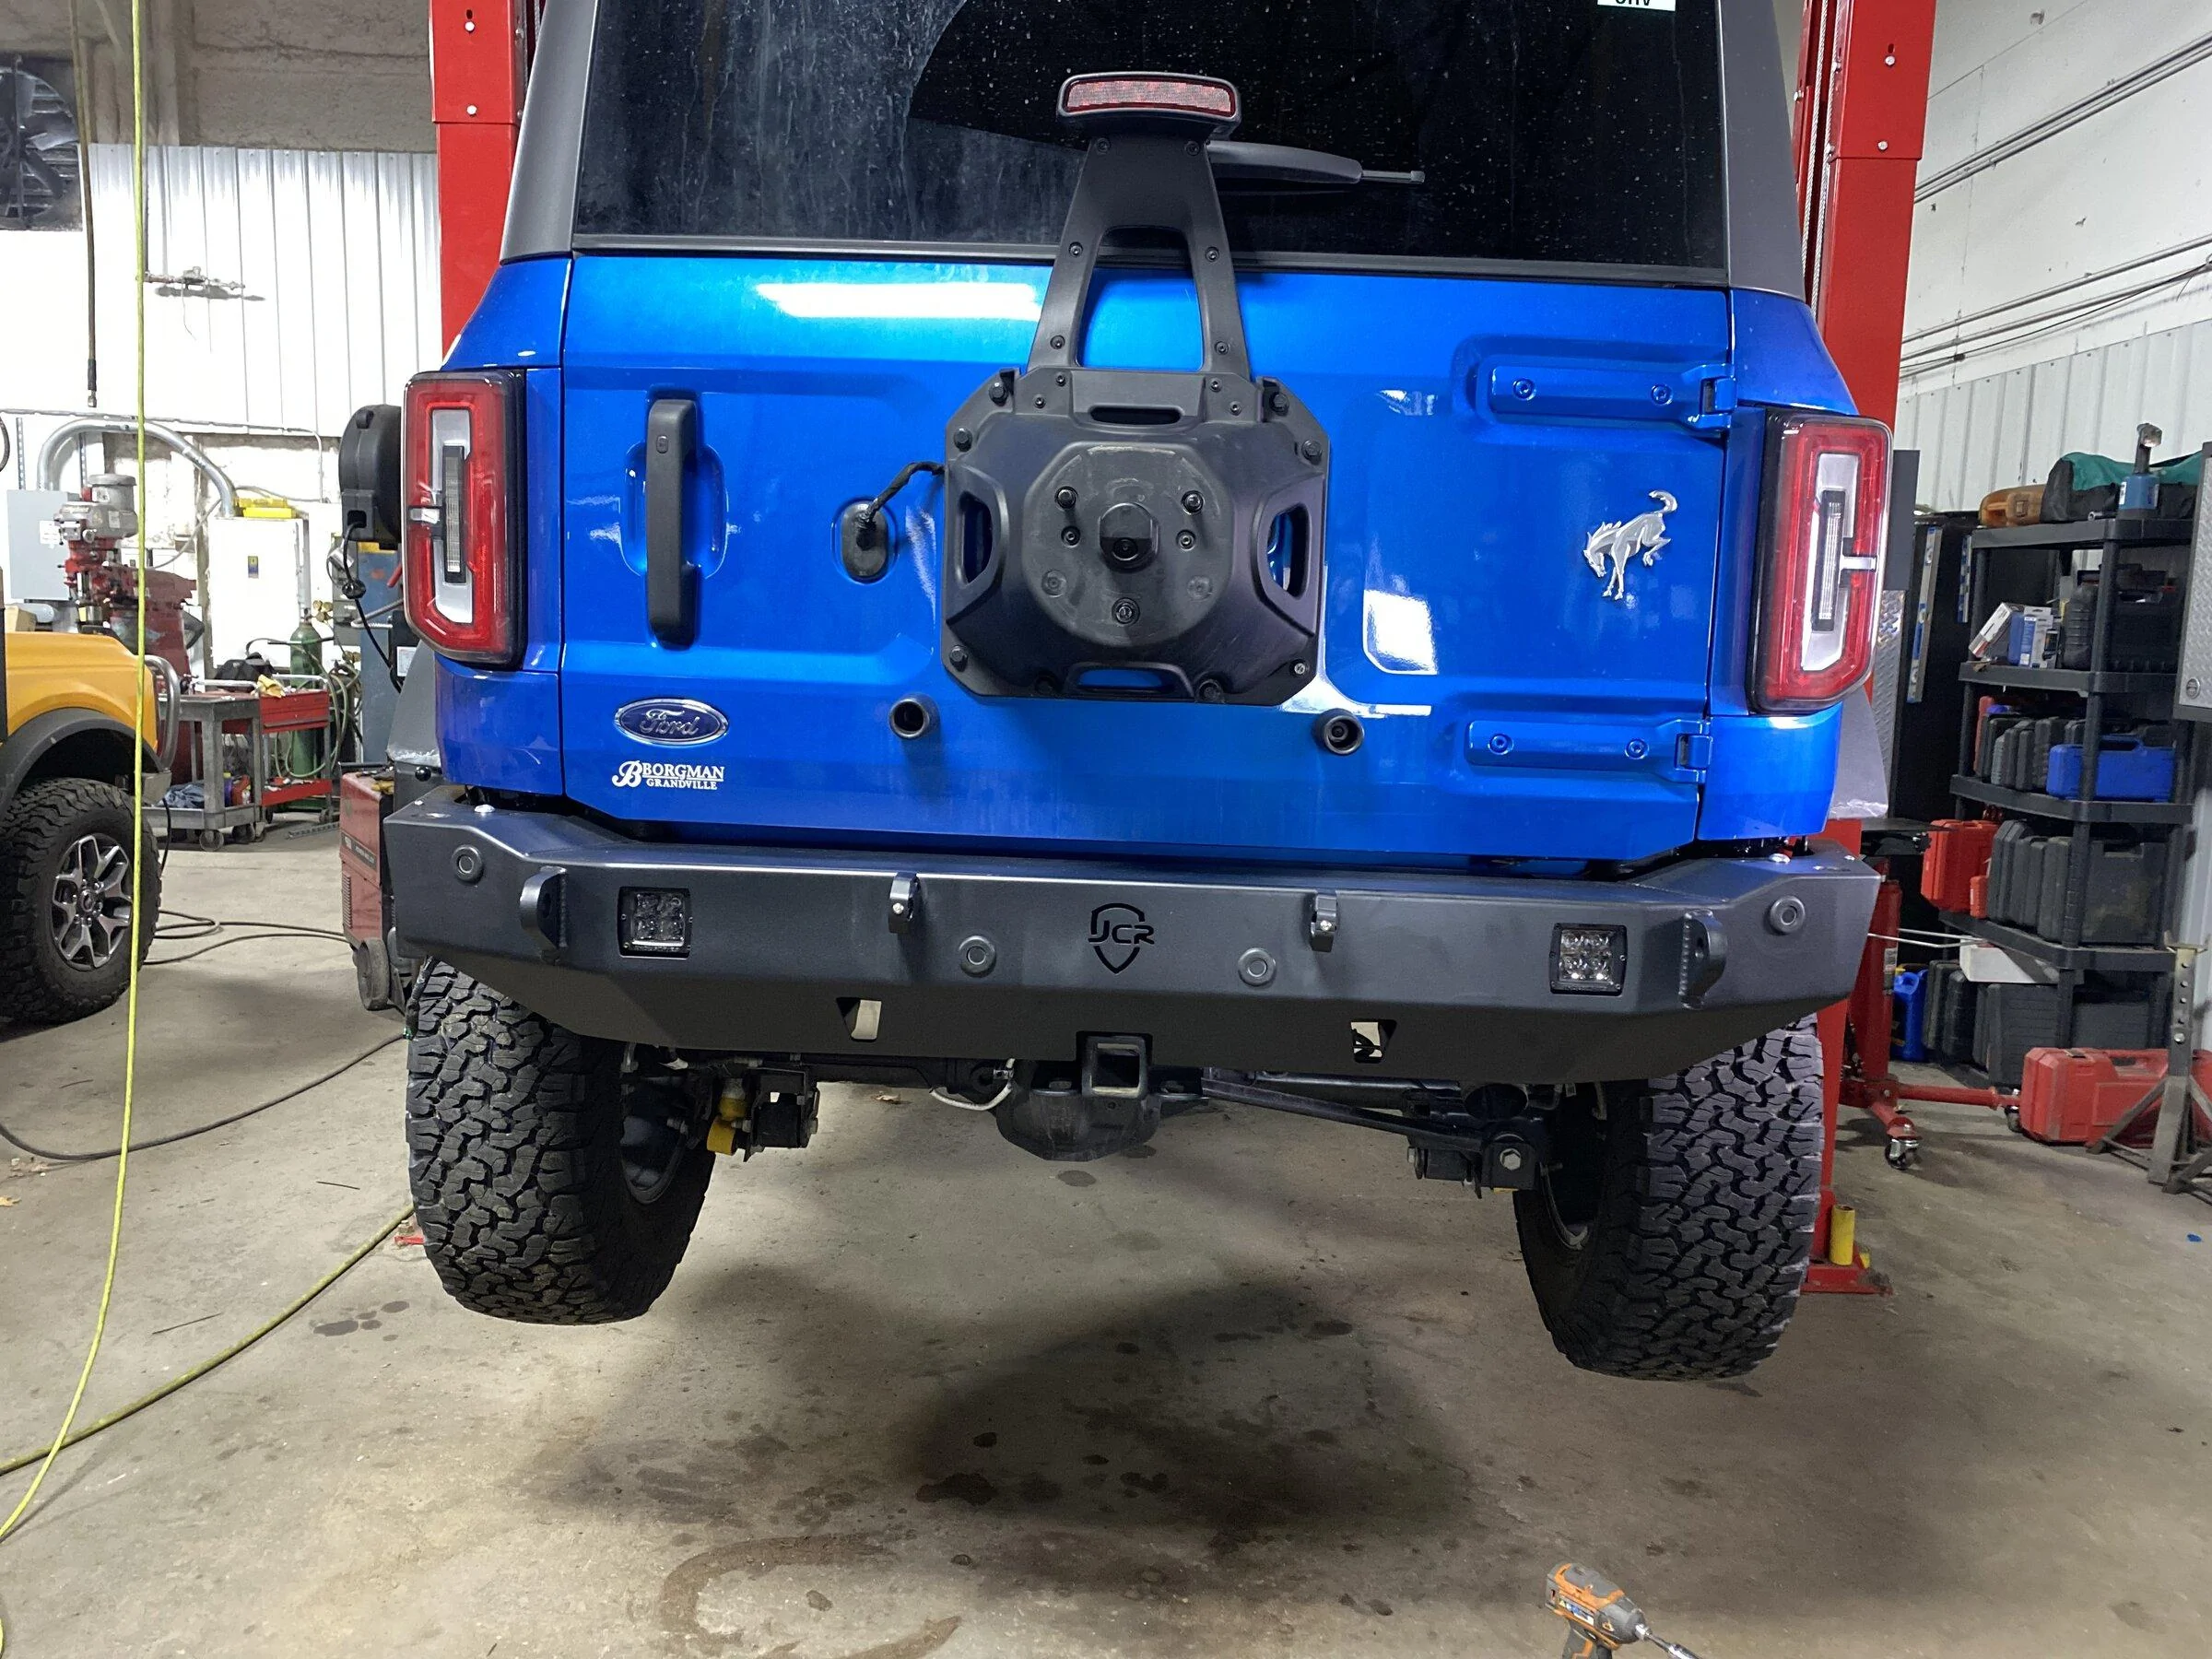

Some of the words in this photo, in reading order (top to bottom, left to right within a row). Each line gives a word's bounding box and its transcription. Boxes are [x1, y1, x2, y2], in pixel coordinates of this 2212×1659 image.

[640, 708, 700, 735] Ford
[643, 762, 724, 781] BORGMAN
[646, 778, 717, 790] GRANDVILLE
[1088, 920, 1155, 945] JCR
